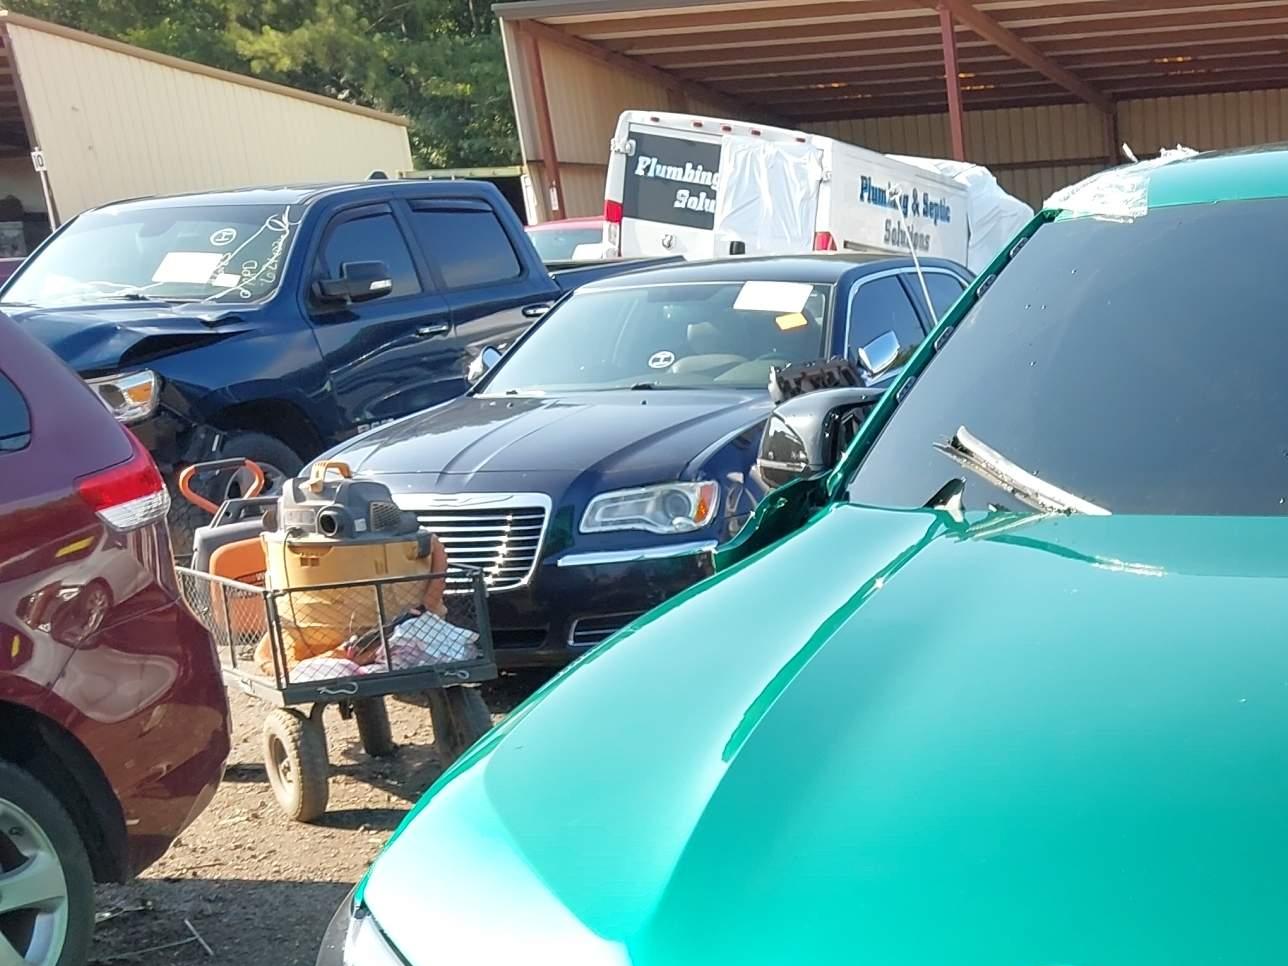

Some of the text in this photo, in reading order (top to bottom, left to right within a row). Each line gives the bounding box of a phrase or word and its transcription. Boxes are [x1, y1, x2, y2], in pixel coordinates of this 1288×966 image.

[635, 155, 720, 191] Plumbing
[911, 187, 920, 217] &
[922, 192, 951, 227] Septic
